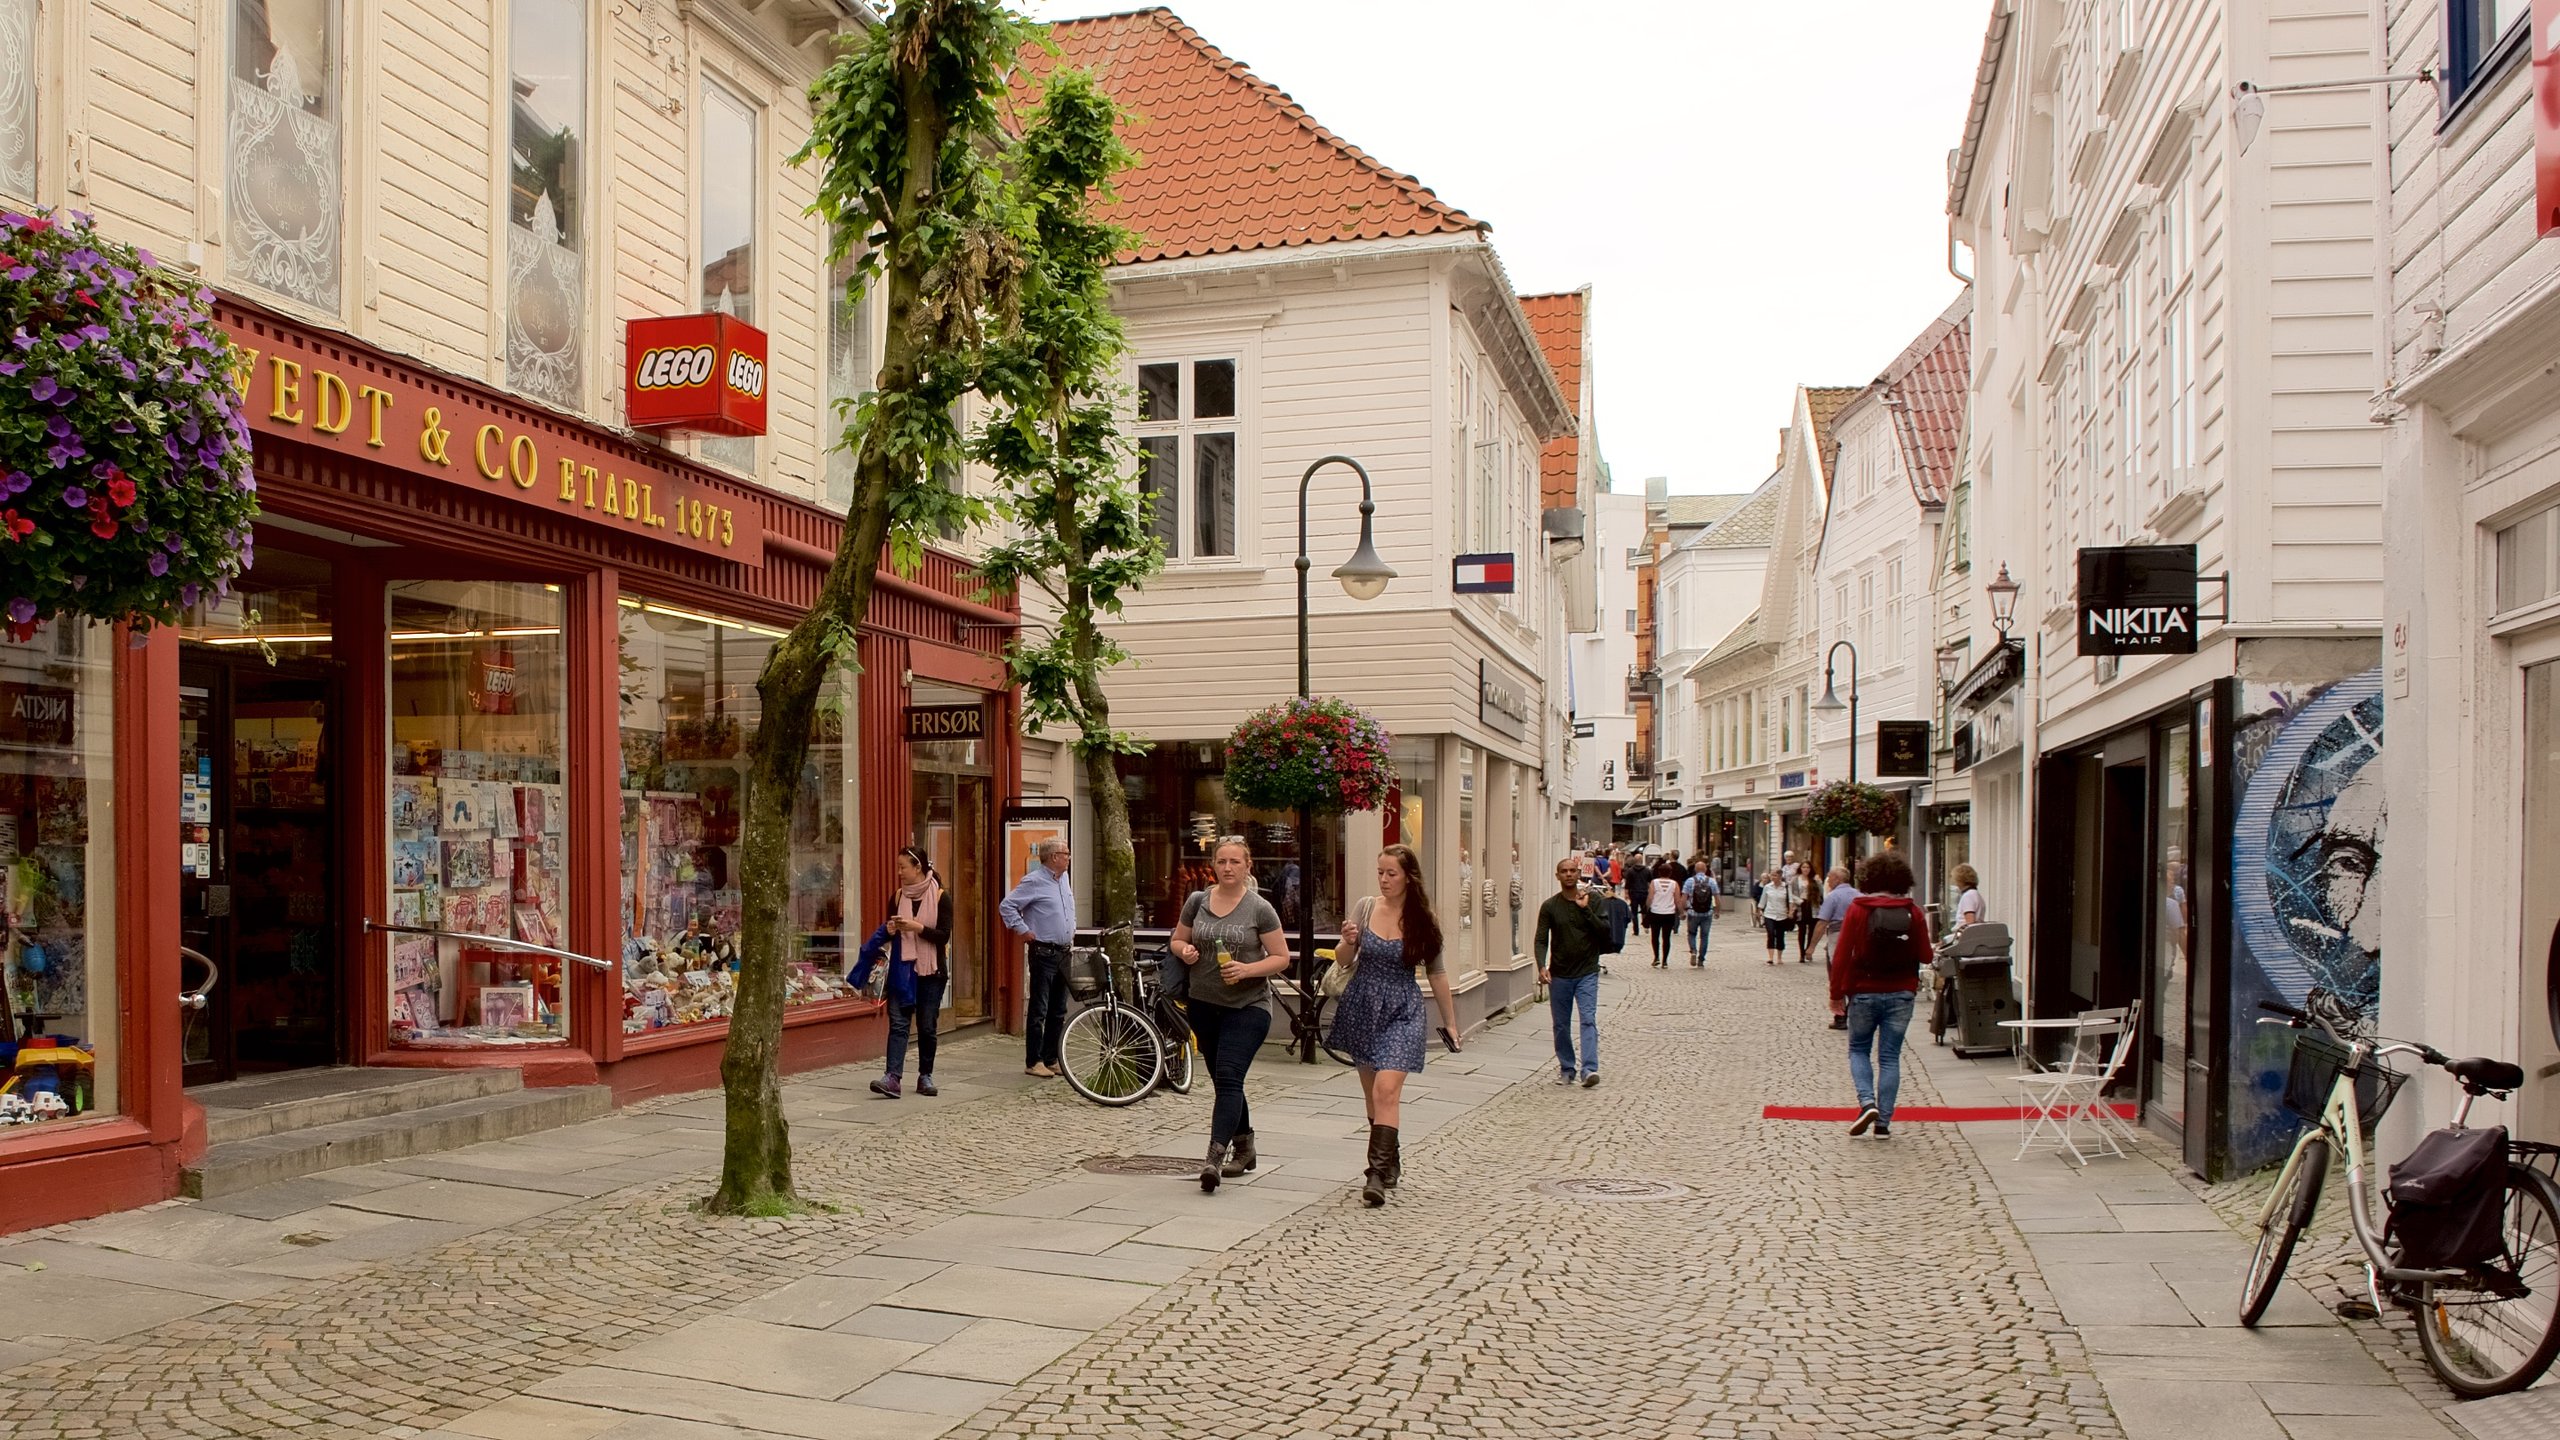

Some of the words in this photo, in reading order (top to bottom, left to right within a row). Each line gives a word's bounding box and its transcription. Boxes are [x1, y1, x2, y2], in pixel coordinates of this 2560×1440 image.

[637, 347, 715, 389] LEGO
[728, 351, 764, 397] LEGO
[418, 406, 452, 467] &
[475, 423, 539, 490] CO
[559, 457, 666, 528] ETABL.
[675, 495, 733, 547] 1873
[2088, 607, 2188, 635] NIKITA
[2114, 636, 2163, 645] HAIR
[486, 670, 514, 694] LEGO
[911, 710, 981, 735] FRISØR
[1219, 922, 1245, 944] LESS
